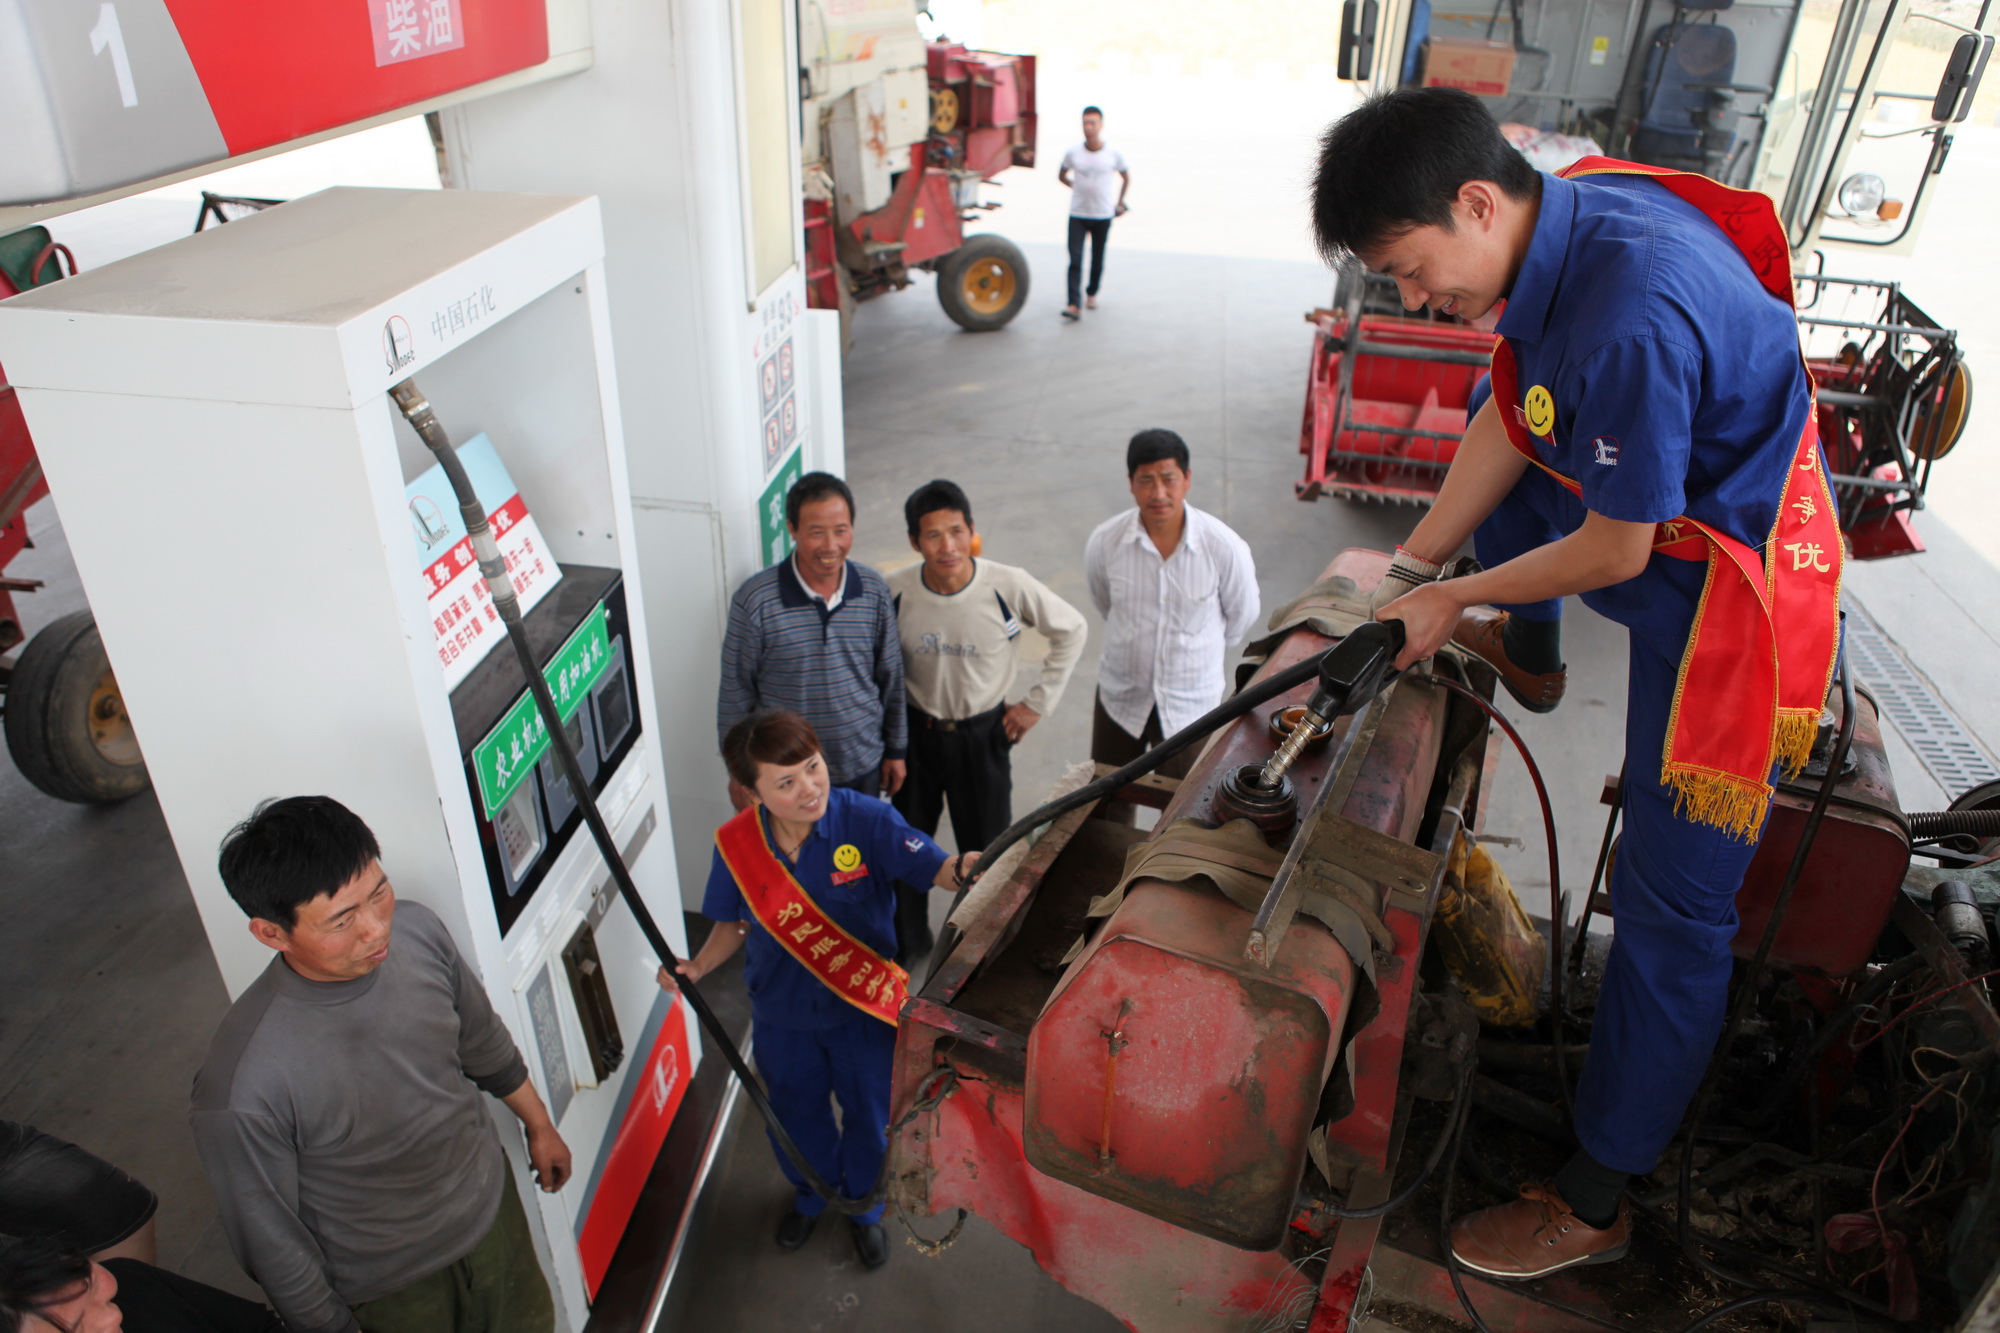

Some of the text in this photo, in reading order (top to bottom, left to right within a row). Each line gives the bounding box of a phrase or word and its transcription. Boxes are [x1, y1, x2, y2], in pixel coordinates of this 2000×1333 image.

[89, 1, 138, 108] 1
[385, 0, 453, 57] 柴油
[430, 284, 496, 342] 中国石化
